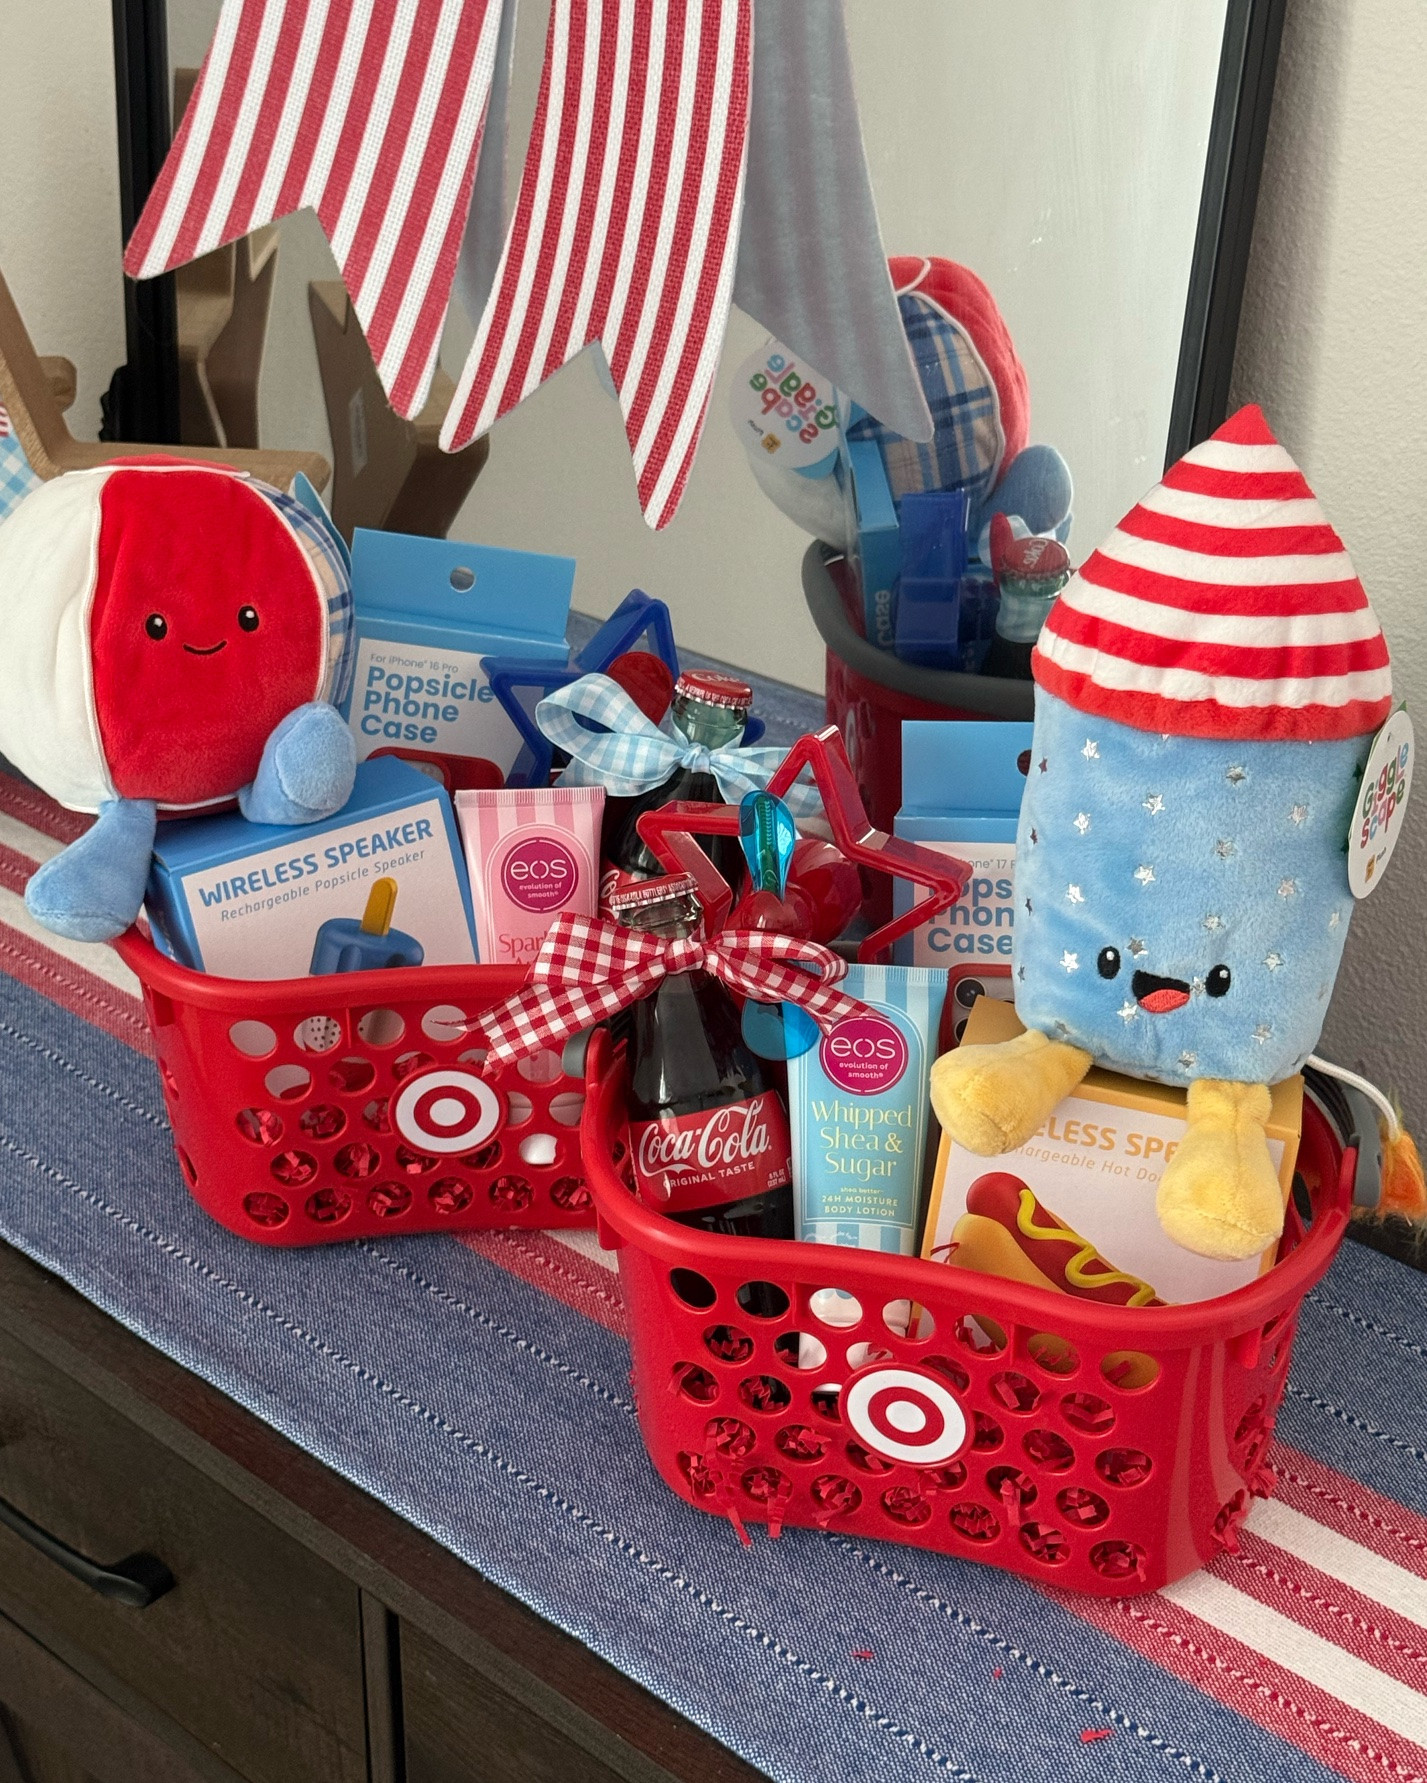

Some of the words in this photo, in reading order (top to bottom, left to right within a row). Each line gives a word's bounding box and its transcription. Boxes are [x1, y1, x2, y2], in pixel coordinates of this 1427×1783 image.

[370, 653, 387, 664] For
[430, 661, 440, 671] 16
[442, 663, 459, 674] Pro
[366, 666, 494, 703] Popsicle
[363, 690, 460, 722] Phone
[360, 714, 438, 743] Case
[199, 853, 319, 908] WIRELESS
[324, 818, 433, 869] SPEAKER
[510, 859, 567, 880] eos
[997, 860, 1007, 869] 17
[221, 885, 310, 922] Rechargeable
[315, 867, 369, 896] Popsicle
[374, 850, 425, 875] Speaker
[519, 882, 553, 891] evolution
[927, 927, 1012, 955] Case
[830, 1036, 896, 1060] eos
[839, 1062, 878, 1070] evolution
[880, 1062, 888, 1070] of
[811, 1100, 913, 1131] Whipped
[638, 1098, 771, 1177] Coca-Cola
[820, 1126, 880, 1151] Shea
[884, 1132, 904, 1154] &
[718, 1161, 755, 1178] TASTE
[825, 1151, 897, 1182] Sugar
[1101, 1160, 1130, 1177] Hot
[1136, 1168, 1162, 1183] Do
[822, 1195, 841, 1203] 24H
[845, 1196, 898, 1207] MOISTURE
[824, 1205, 853, 1214] BODY
[857, 1207, 895, 1217] LOTION
